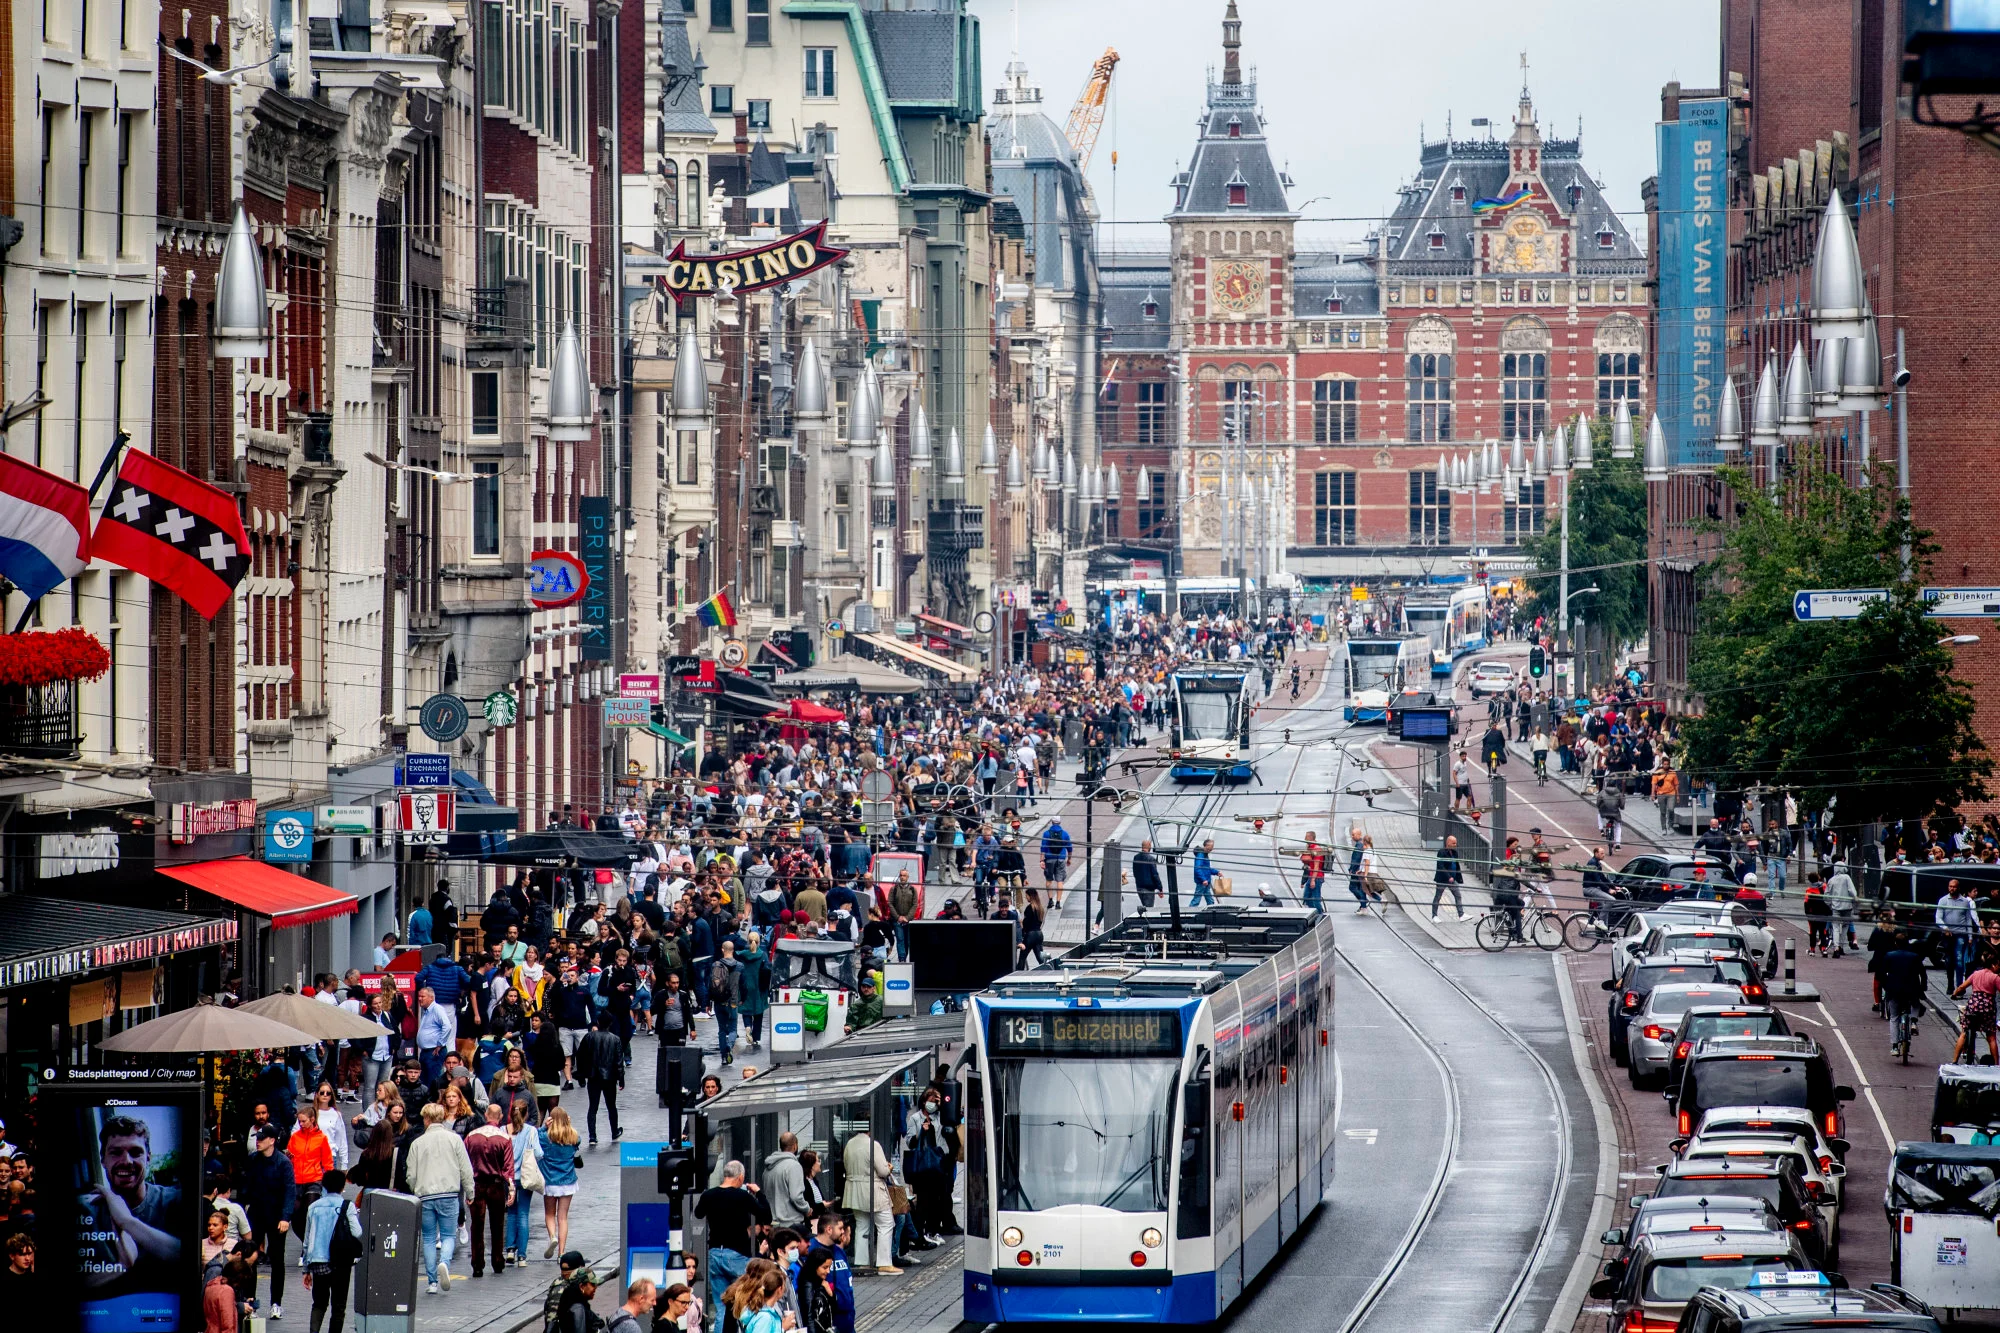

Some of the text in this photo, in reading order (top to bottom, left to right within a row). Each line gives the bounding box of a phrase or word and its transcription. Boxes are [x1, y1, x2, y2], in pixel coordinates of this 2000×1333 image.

[1691, 109, 1715, 117] FOOD
[665, 239, 817, 291] CASINO
[1692, 140, 1712, 427] BEURS VAN BERLAGE
[530, 565, 576, 593] C&A
[587, 515, 605, 641] PRIMARK
[1940, 592, 1993, 602] De Bijenkorf
[622, 689, 658, 697] WORLDS
[611, 702, 643, 710] TULIP
[608, 713, 647, 722] HOUSE
[418, 776, 438, 784] ATM
[278, 821, 295, 834] to
[283, 831, 301, 846] go
[411, 831, 442, 842] KFC
[157, 933, 171, 955] DE
[1005, 1017, 1160, 1044] 13 Geuzenveld
[68, 1069, 149, 1080] Stadsplattegrond
[156, 1068, 174, 1079] City
[175, 1070, 196, 1079] map
[1043, 1250, 1061, 1258] 2101
